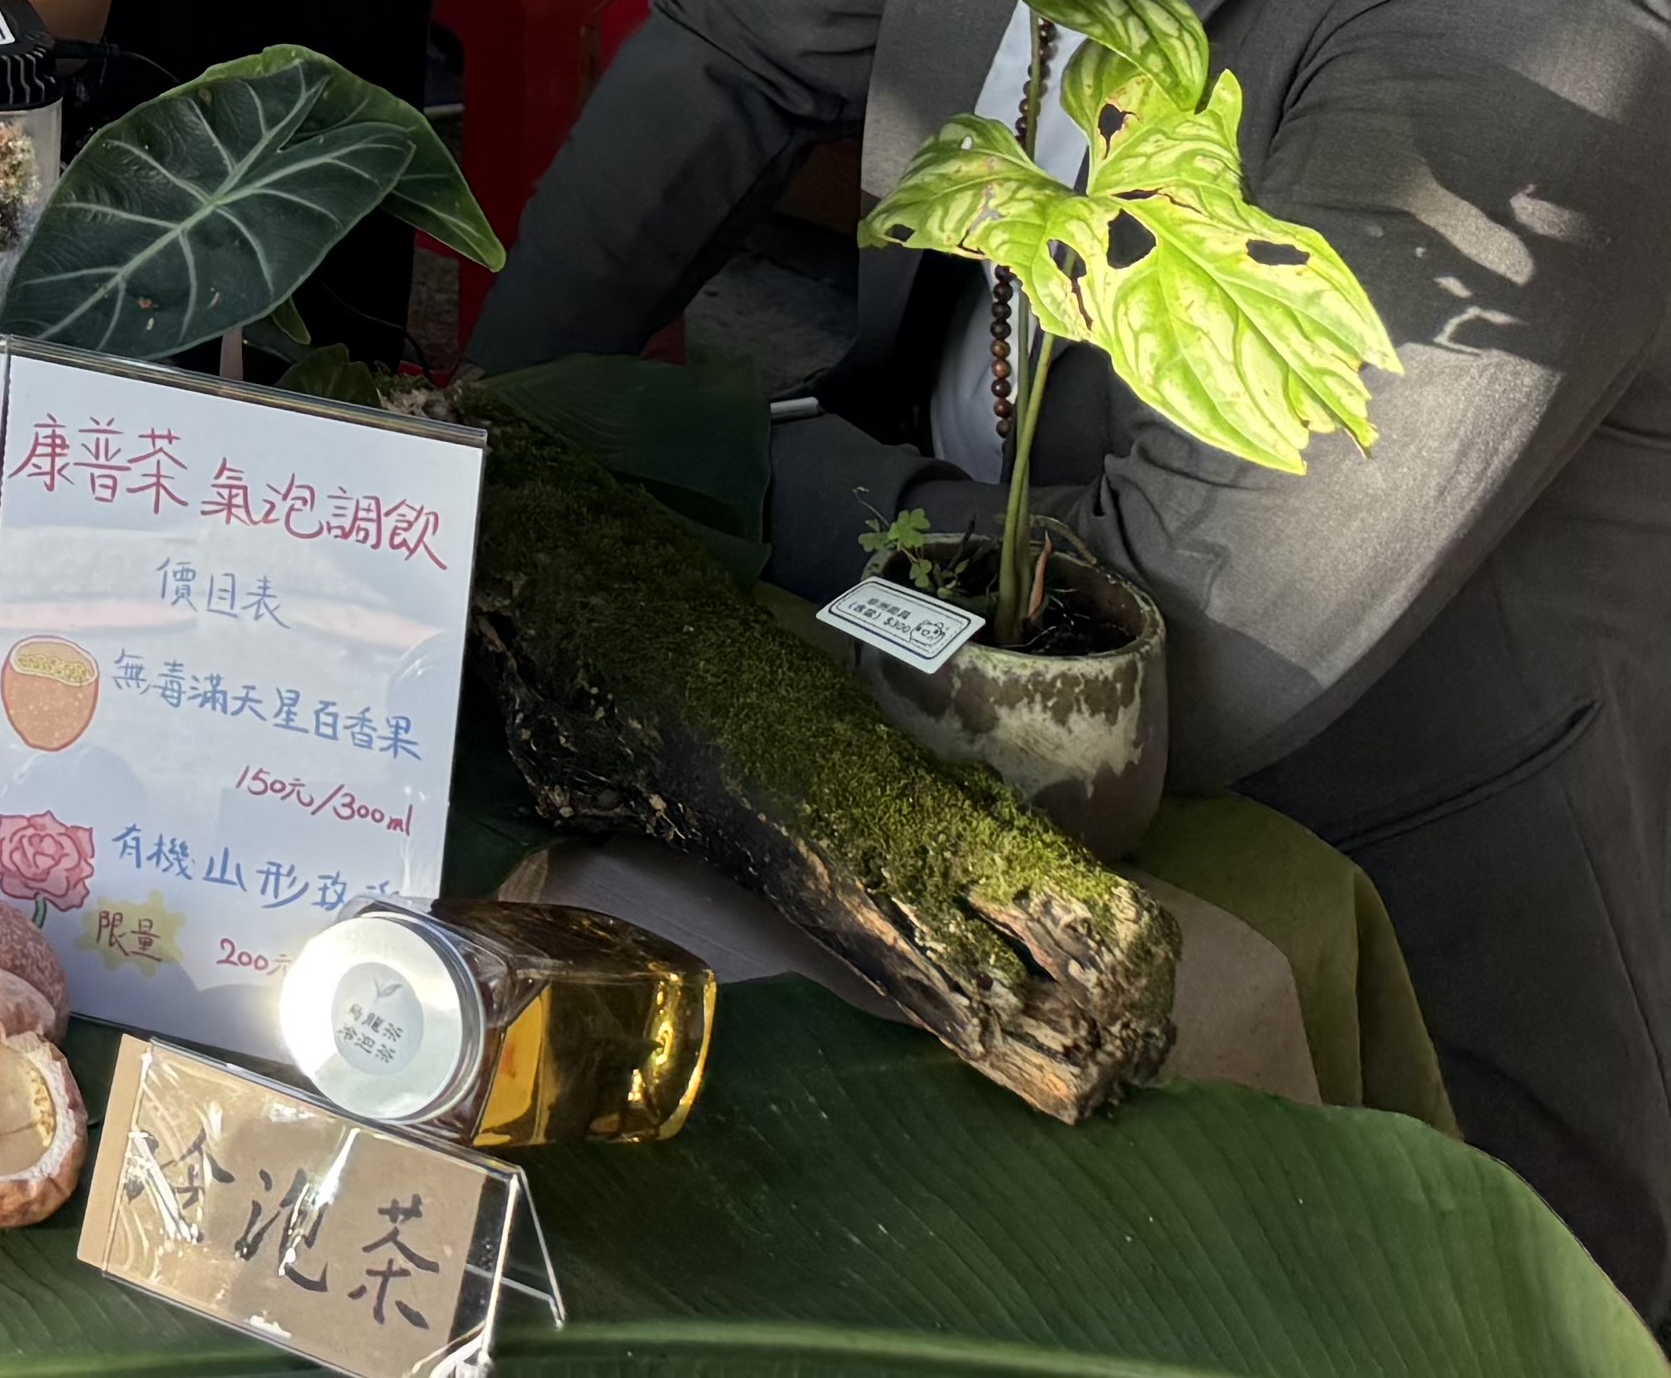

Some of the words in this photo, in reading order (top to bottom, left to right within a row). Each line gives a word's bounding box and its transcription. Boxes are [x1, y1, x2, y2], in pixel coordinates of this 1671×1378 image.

[8, 412, 189, 515] 康普茶
[199, 456, 448, 571] 氣泡調飲
[156, 555, 291, 630] 價目表
[112, 646, 423, 762] 無毒滿天星百香果
[234, 764, 414, 837] 150元/300ml
[111, 822, 400, 911] 有機山形玫
[95, 909, 163, 964] 限量
